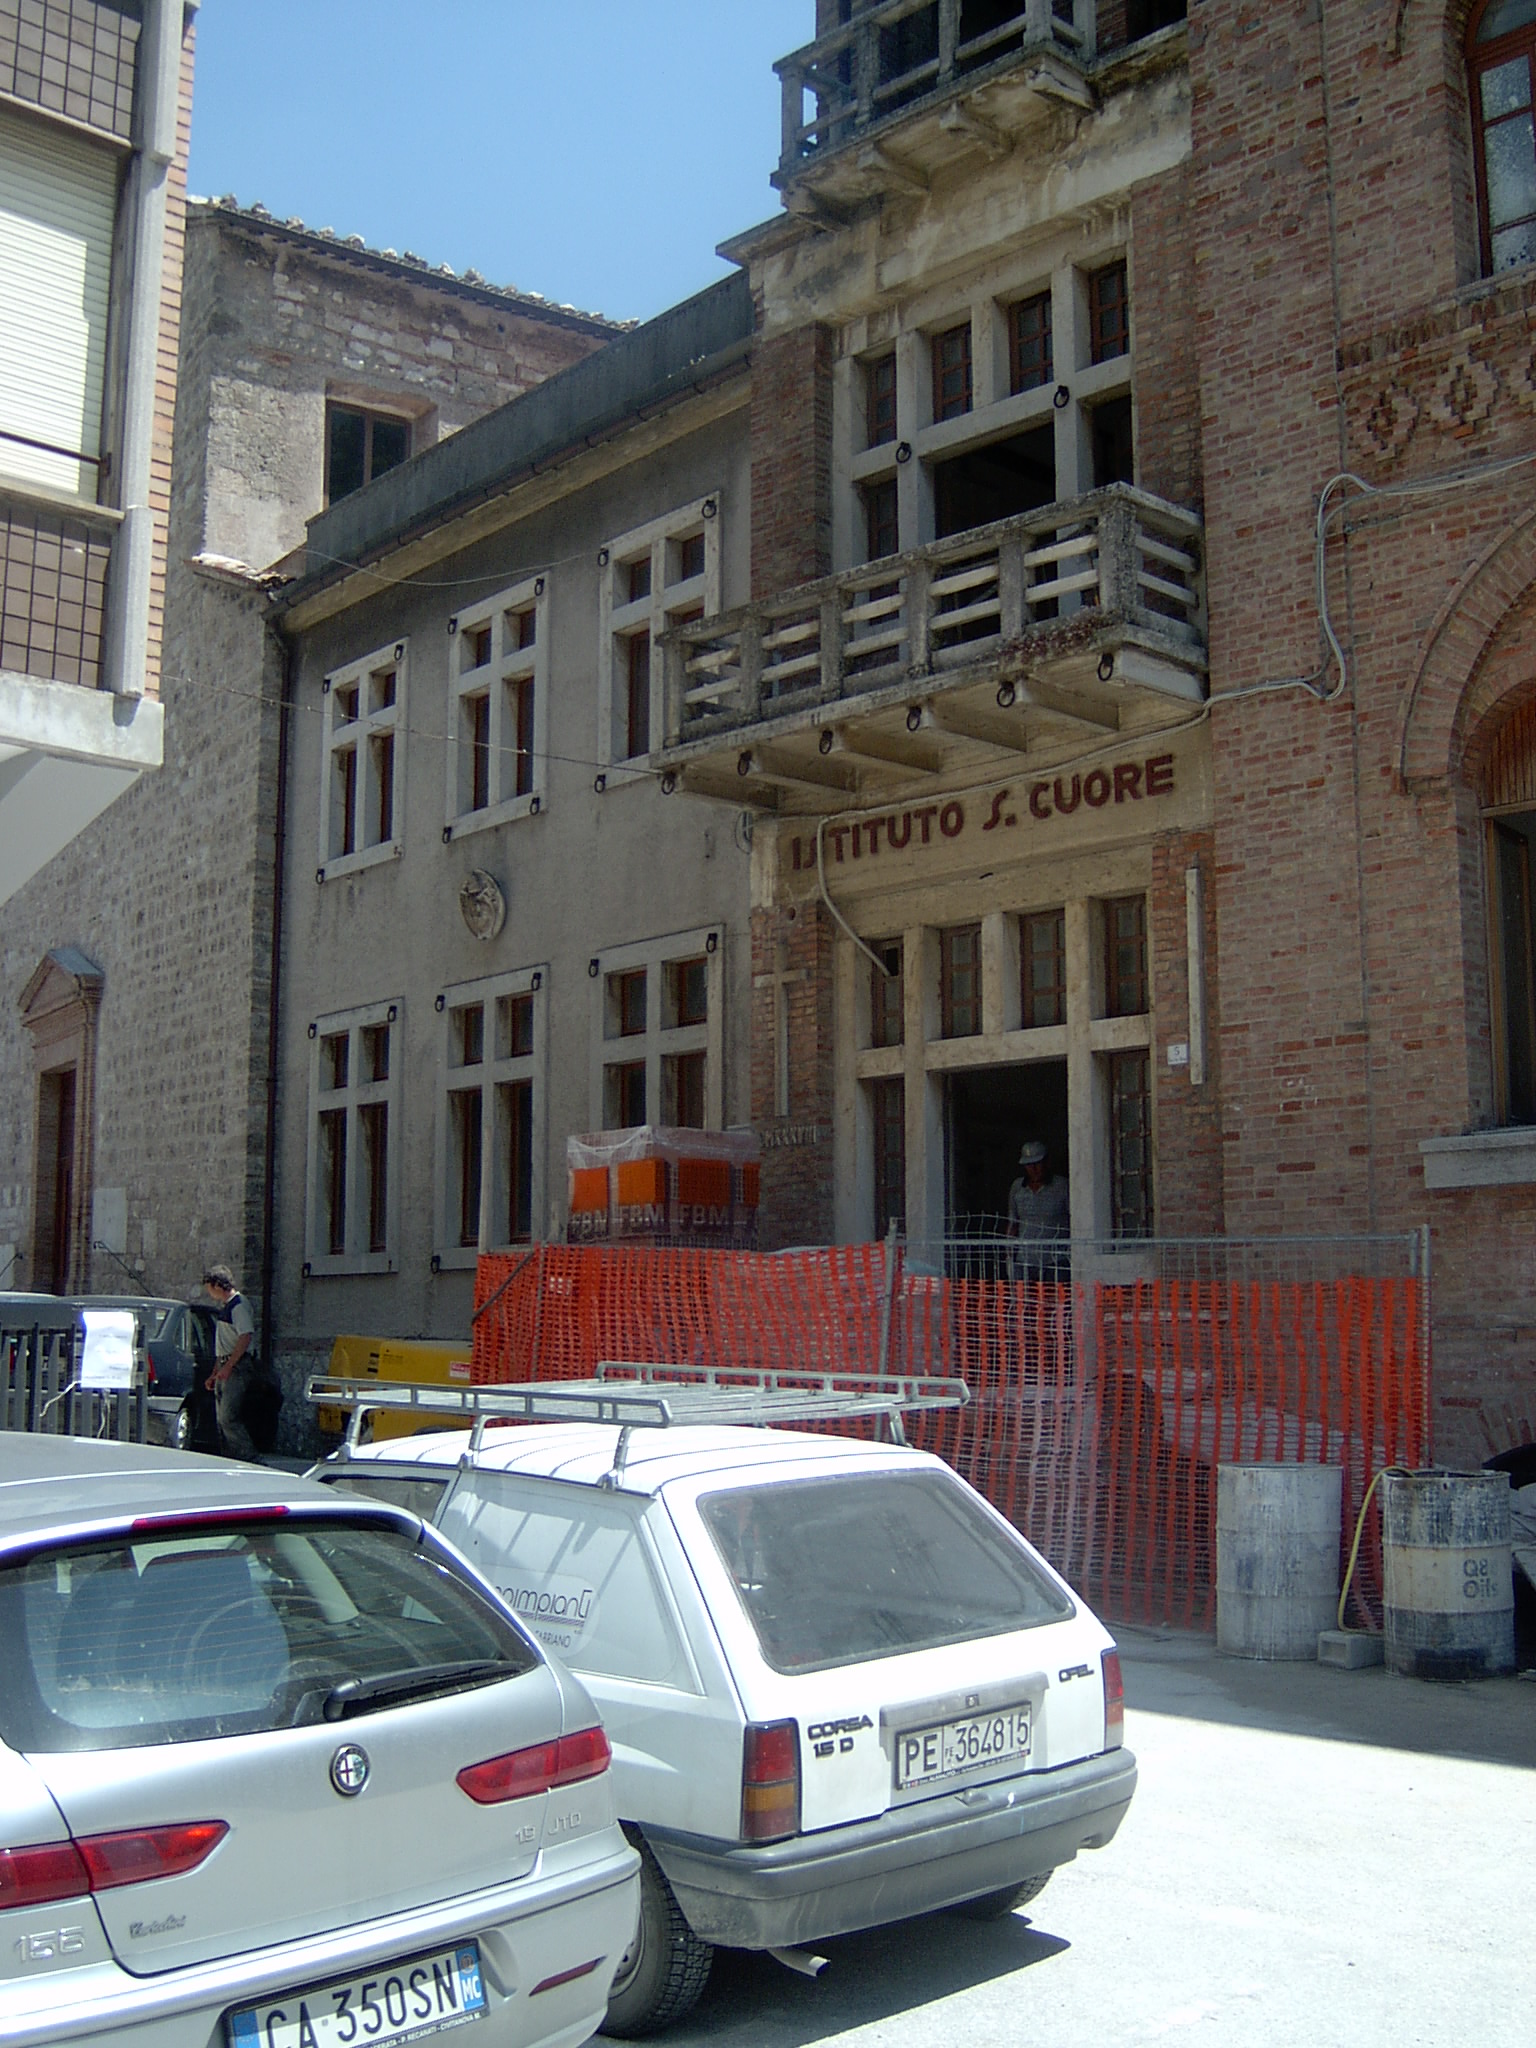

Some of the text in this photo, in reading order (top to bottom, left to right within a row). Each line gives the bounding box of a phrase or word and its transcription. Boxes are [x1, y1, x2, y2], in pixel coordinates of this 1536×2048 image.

[791, 801, 964, 871] ISTITUTO
[1029, 754, 1175, 820] CUORE
[618, 1203, 665, 1227] FBM
[1463, 1558, 1488, 1577] Q8
[1058, 1663, 1095, 1683] OPEL
[807, 1714, 874, 1741] CORSA
[839, 1736, 855, 1754] D
[905, 1733, 938, 1777] PE
[955, 1711, 1029, 1762] 364815
[548, 1811, 582, 1836] JTD
[14, 1925, 85, 1961] 156
[461, 1975, 482, 2003] MC
[265, 1959, 458, 2048] CA 350SN
